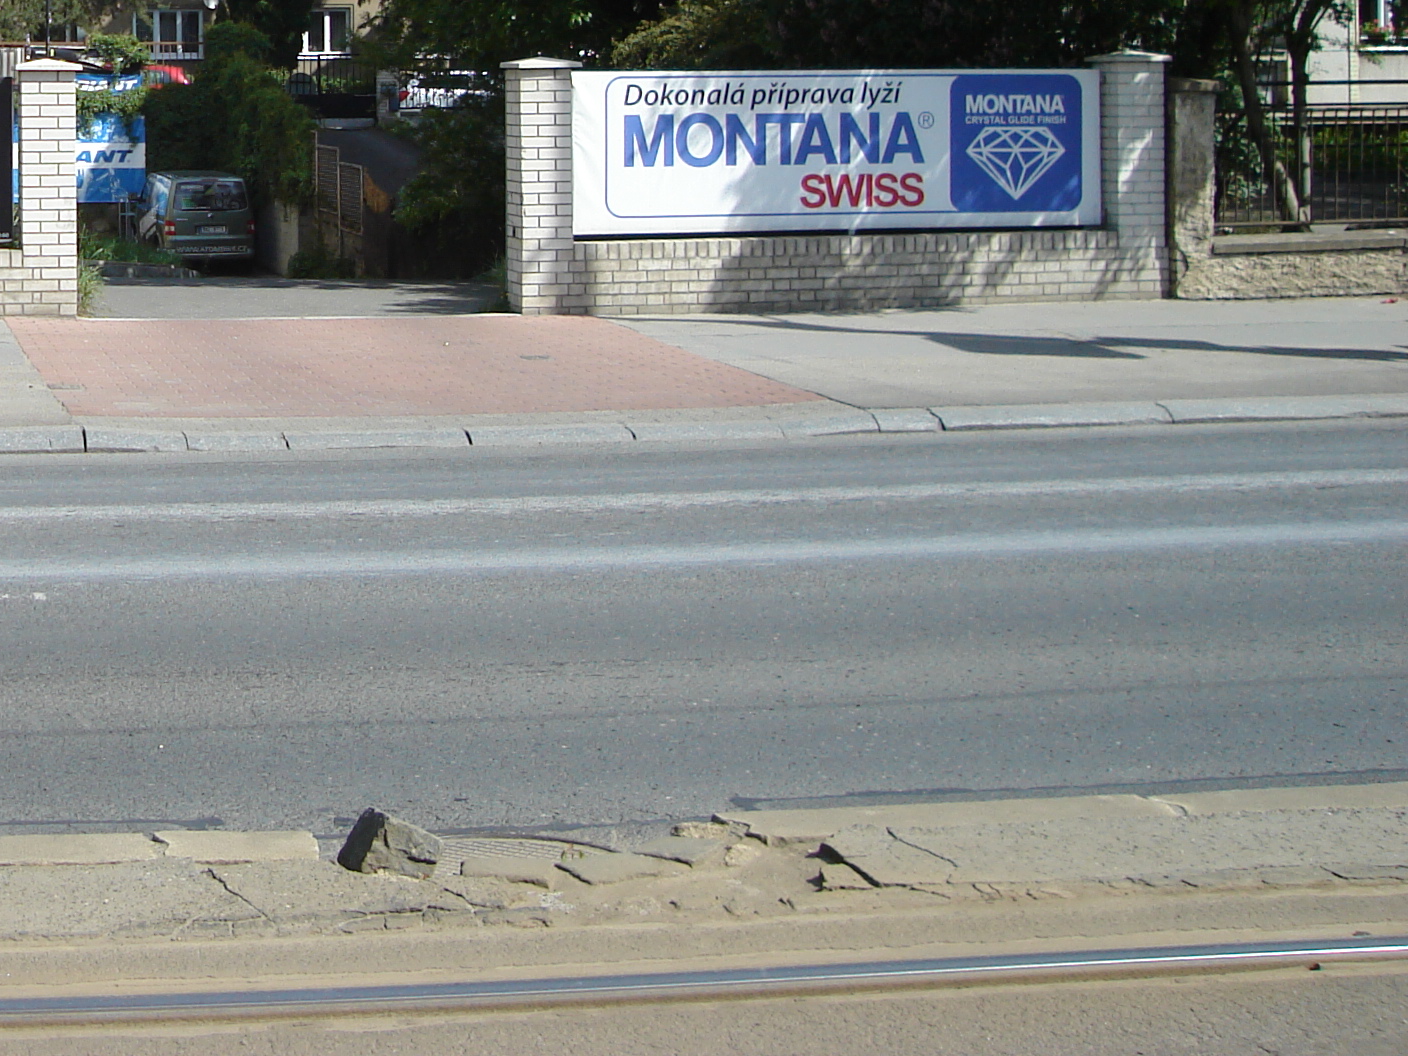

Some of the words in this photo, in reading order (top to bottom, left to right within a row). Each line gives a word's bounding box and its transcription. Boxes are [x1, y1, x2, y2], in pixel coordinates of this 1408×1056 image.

[623, 82, 745, 107] Dokonalá
[750, 83, 855, 112] příprava
[860, 82, 902, 106] lyží
[965, 94, 1065, 114] MONTANA
[965, 115, 1006, 124] CRYSTAL
[1008, 116, 1035, 124] GLIDE
[1037, 115, 1067, 124] FINISH
[800, 173, 925, 209] SWISS
